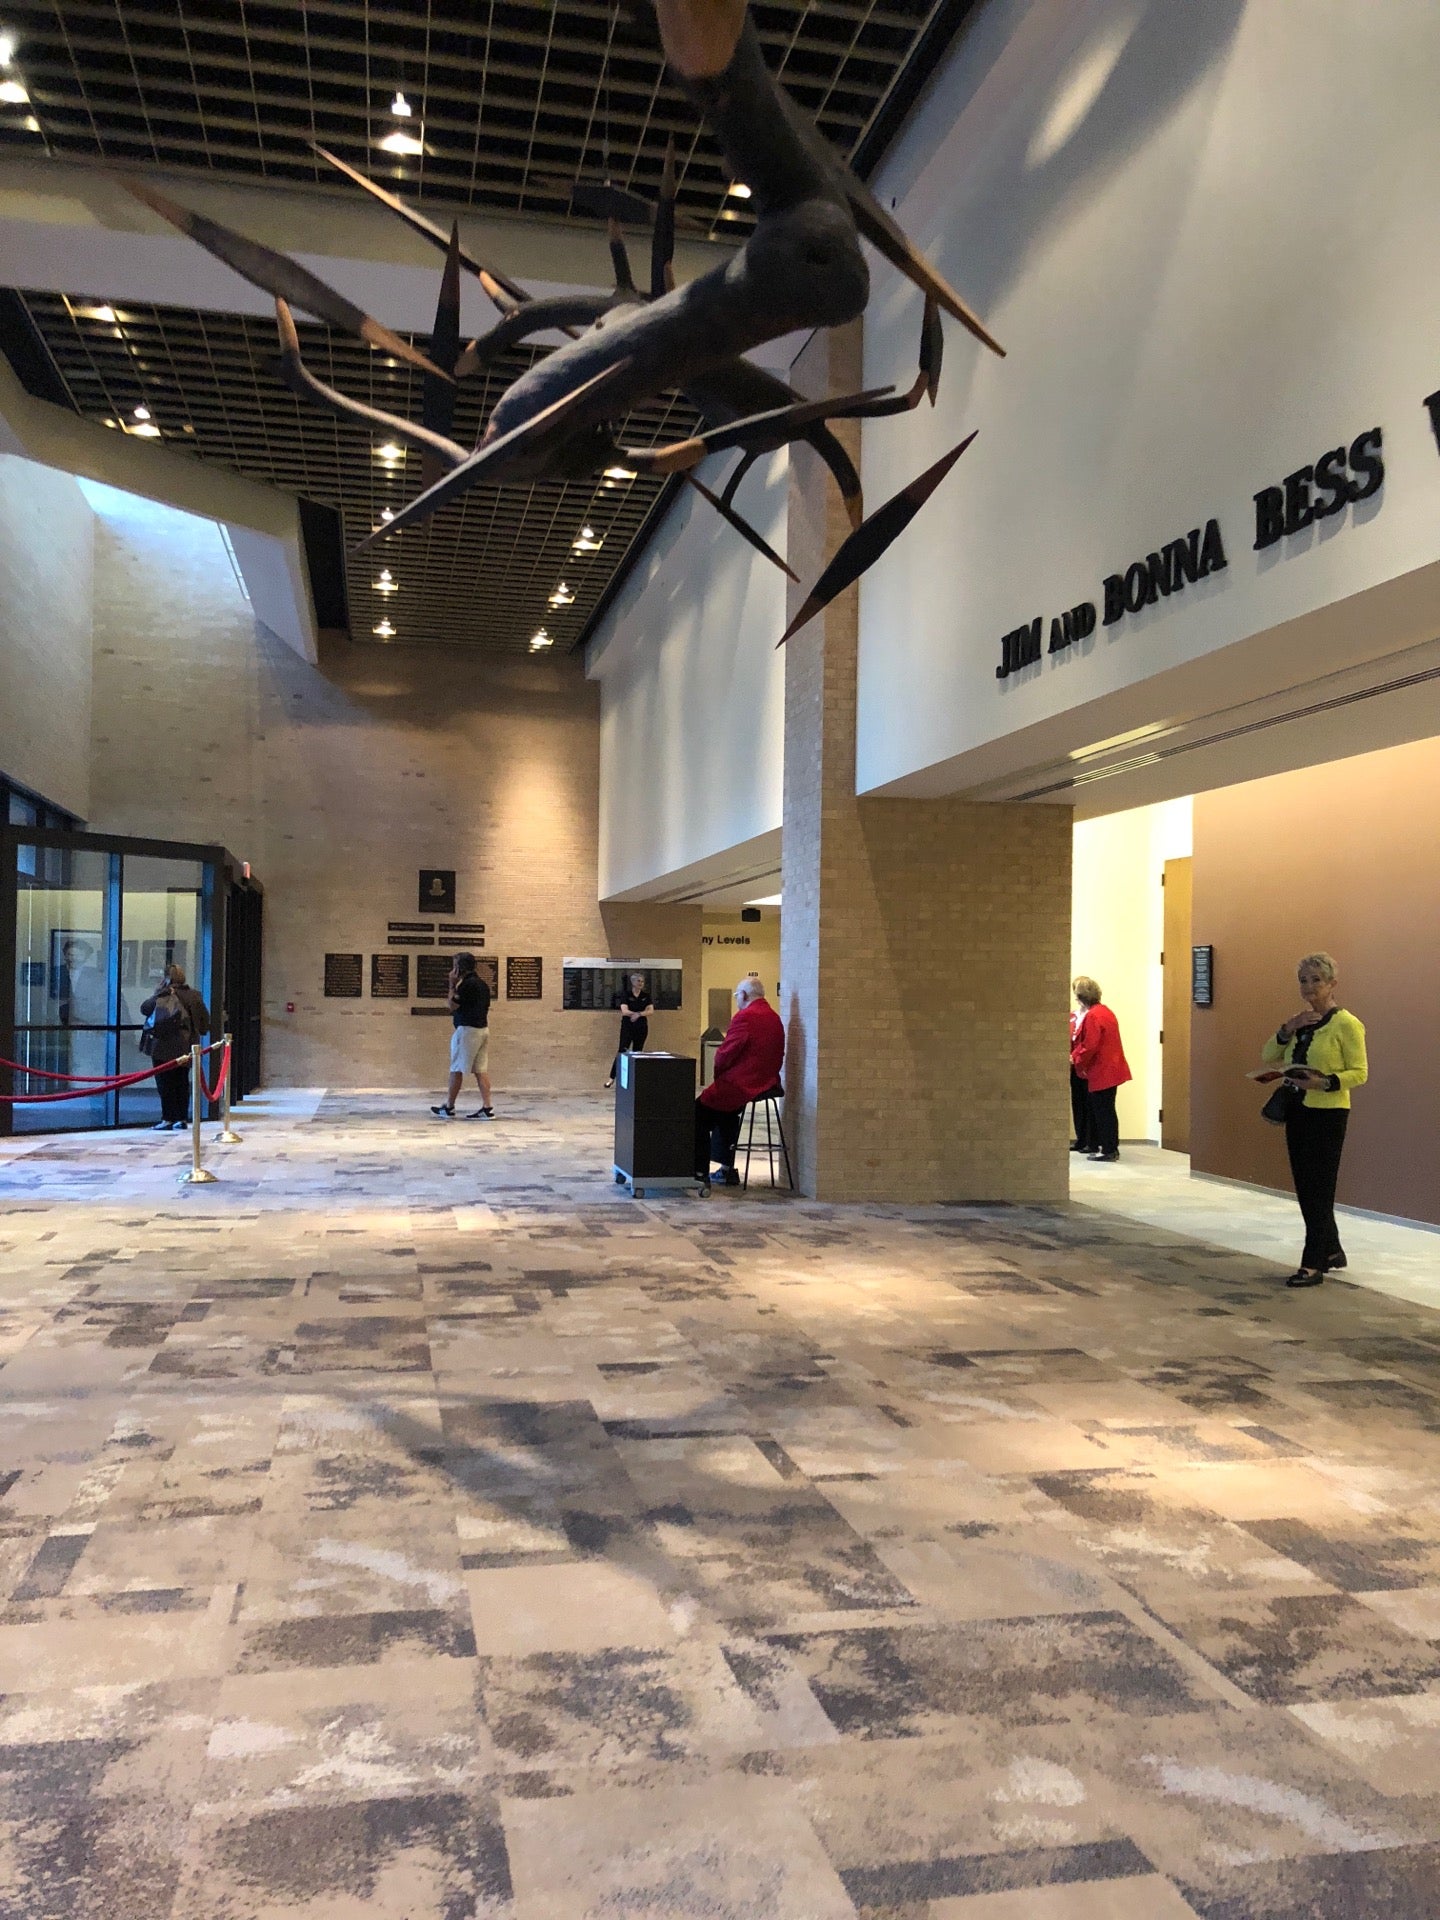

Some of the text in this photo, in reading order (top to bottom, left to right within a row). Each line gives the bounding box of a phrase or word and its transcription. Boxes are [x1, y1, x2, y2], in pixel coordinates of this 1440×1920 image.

[995, 427, 1385, 679] JIM AND BONNA BESS
[717, 935, 751, 945] Levels
